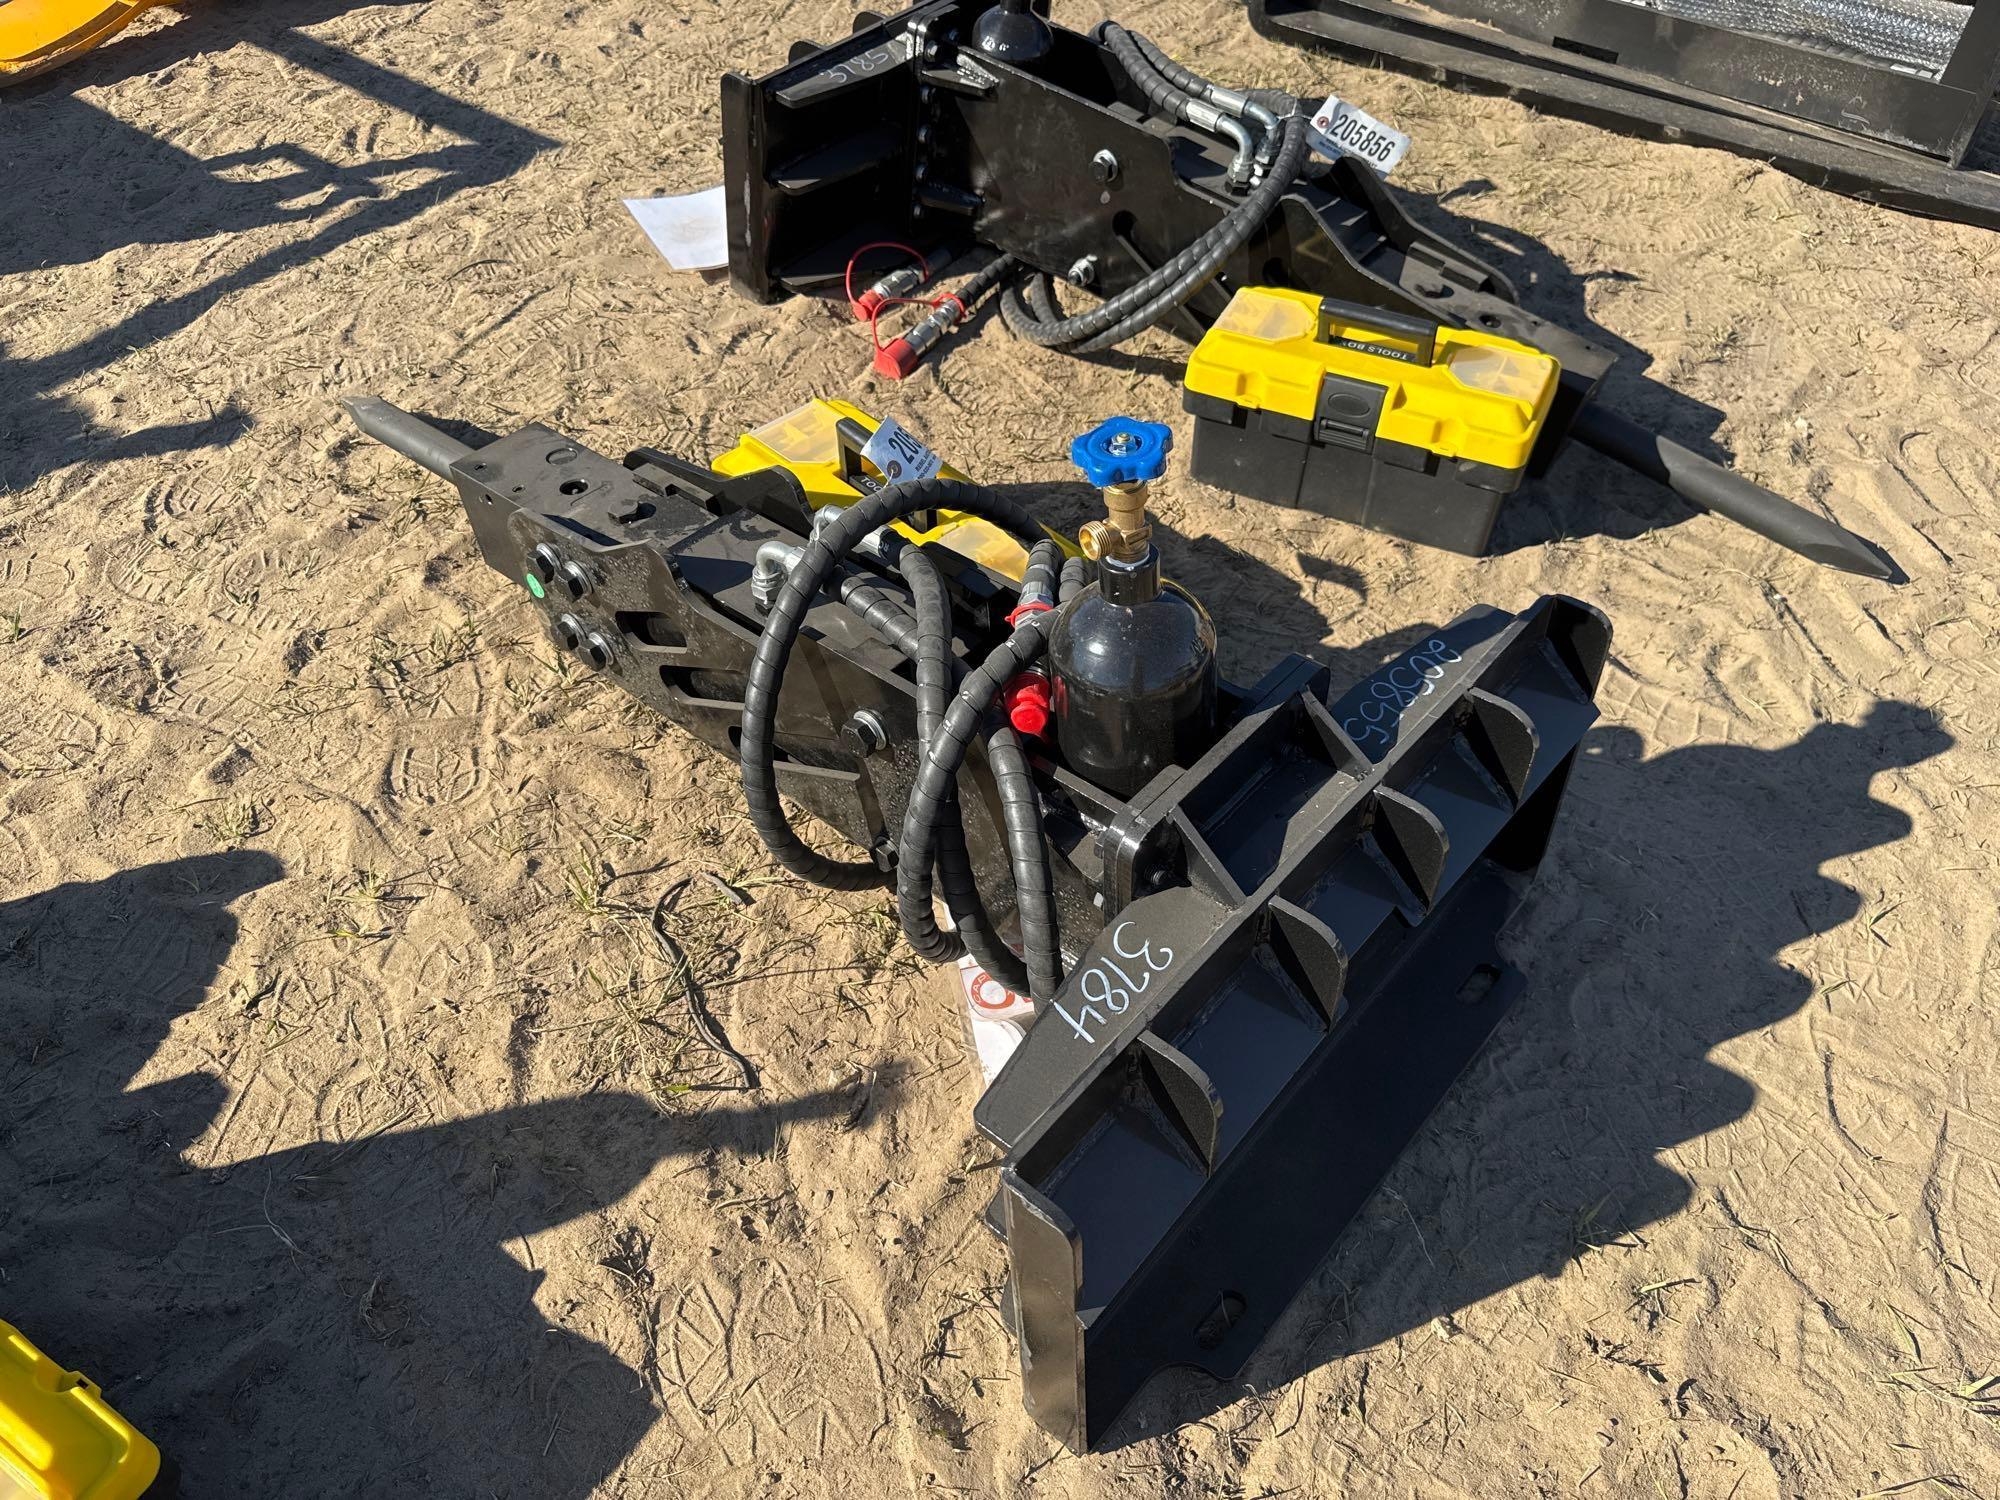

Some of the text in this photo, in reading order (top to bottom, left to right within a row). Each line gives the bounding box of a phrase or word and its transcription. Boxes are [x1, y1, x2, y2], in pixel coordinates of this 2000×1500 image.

[1329, 114, 1396, 162] 205856
[1366, 345, 1408, 360] TOOLS
[1344, 639, 1462, 745] 205855
[1049, 921, 1174, 1044] 3784
